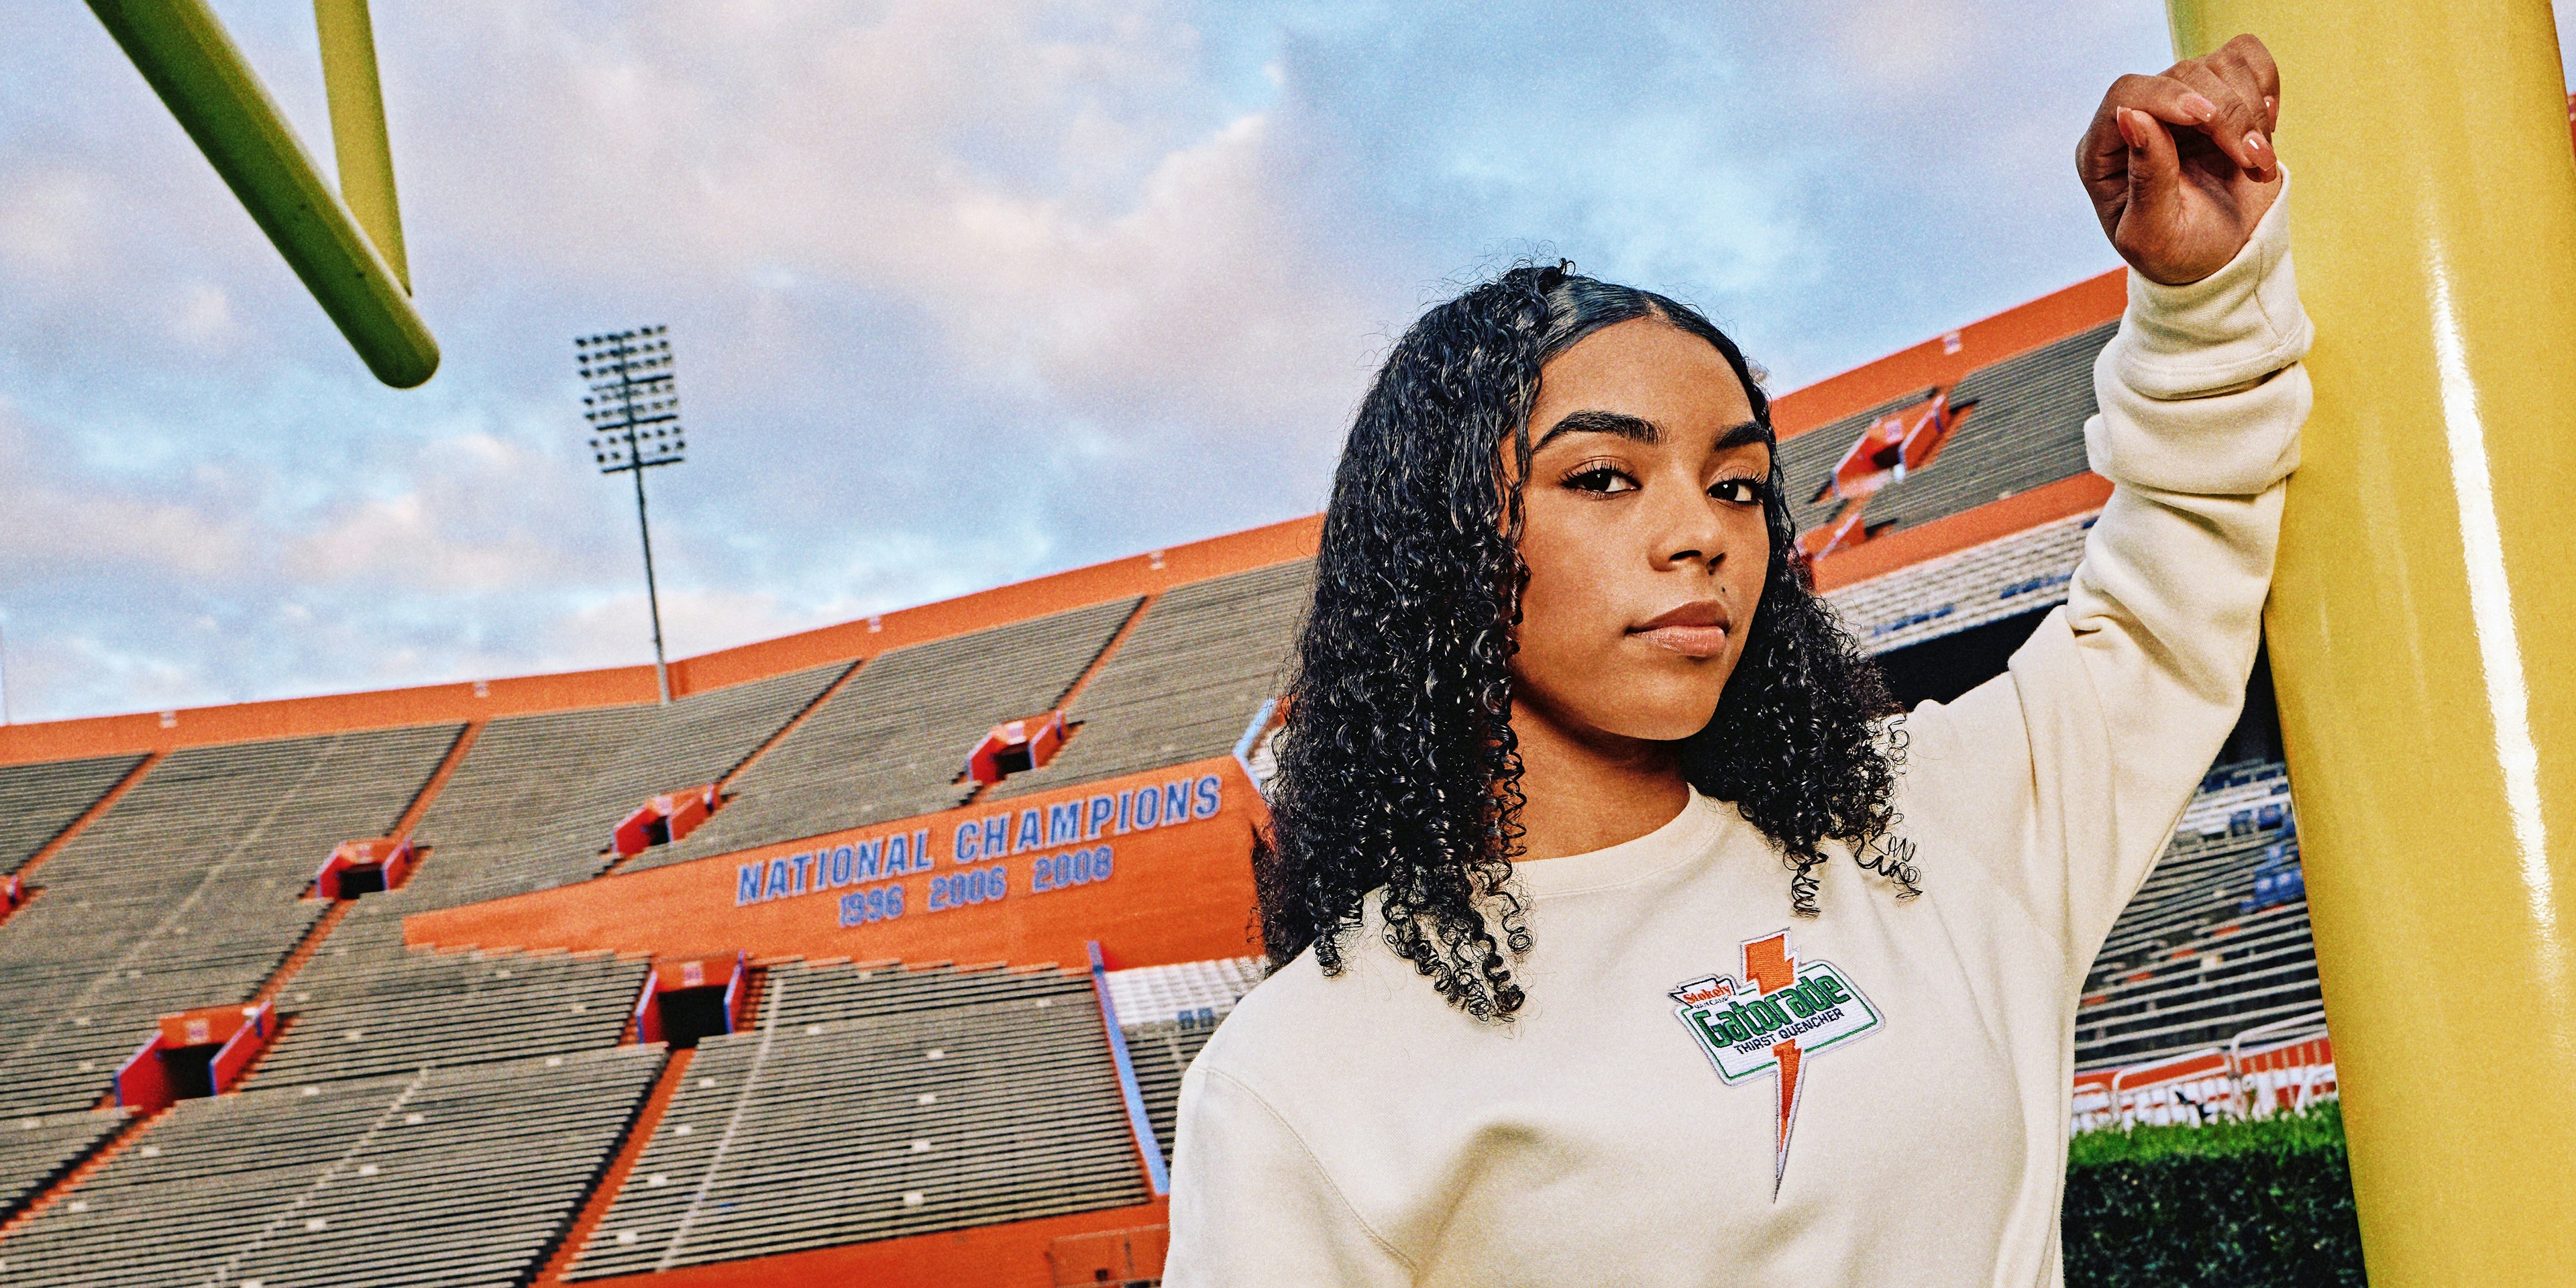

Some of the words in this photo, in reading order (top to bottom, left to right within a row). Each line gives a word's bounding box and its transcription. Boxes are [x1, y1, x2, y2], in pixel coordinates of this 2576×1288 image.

[737, 829, 934, 906] NATIONAL
[954, 775, 1222, 863] CHAMPIONS
[839, 884, 904, 927] 1996
[928, 867, 1006, 912] 2006
[1033, 845, 1114, 893] 2008
[1683, 984, 1731, 1004] Stokely
[1693, 975, 1852, 1049] Gatorade
[1733, 1034, 1776, 1055] THIRST
[1778, 1008, 1845, 1040] QUENCHER
